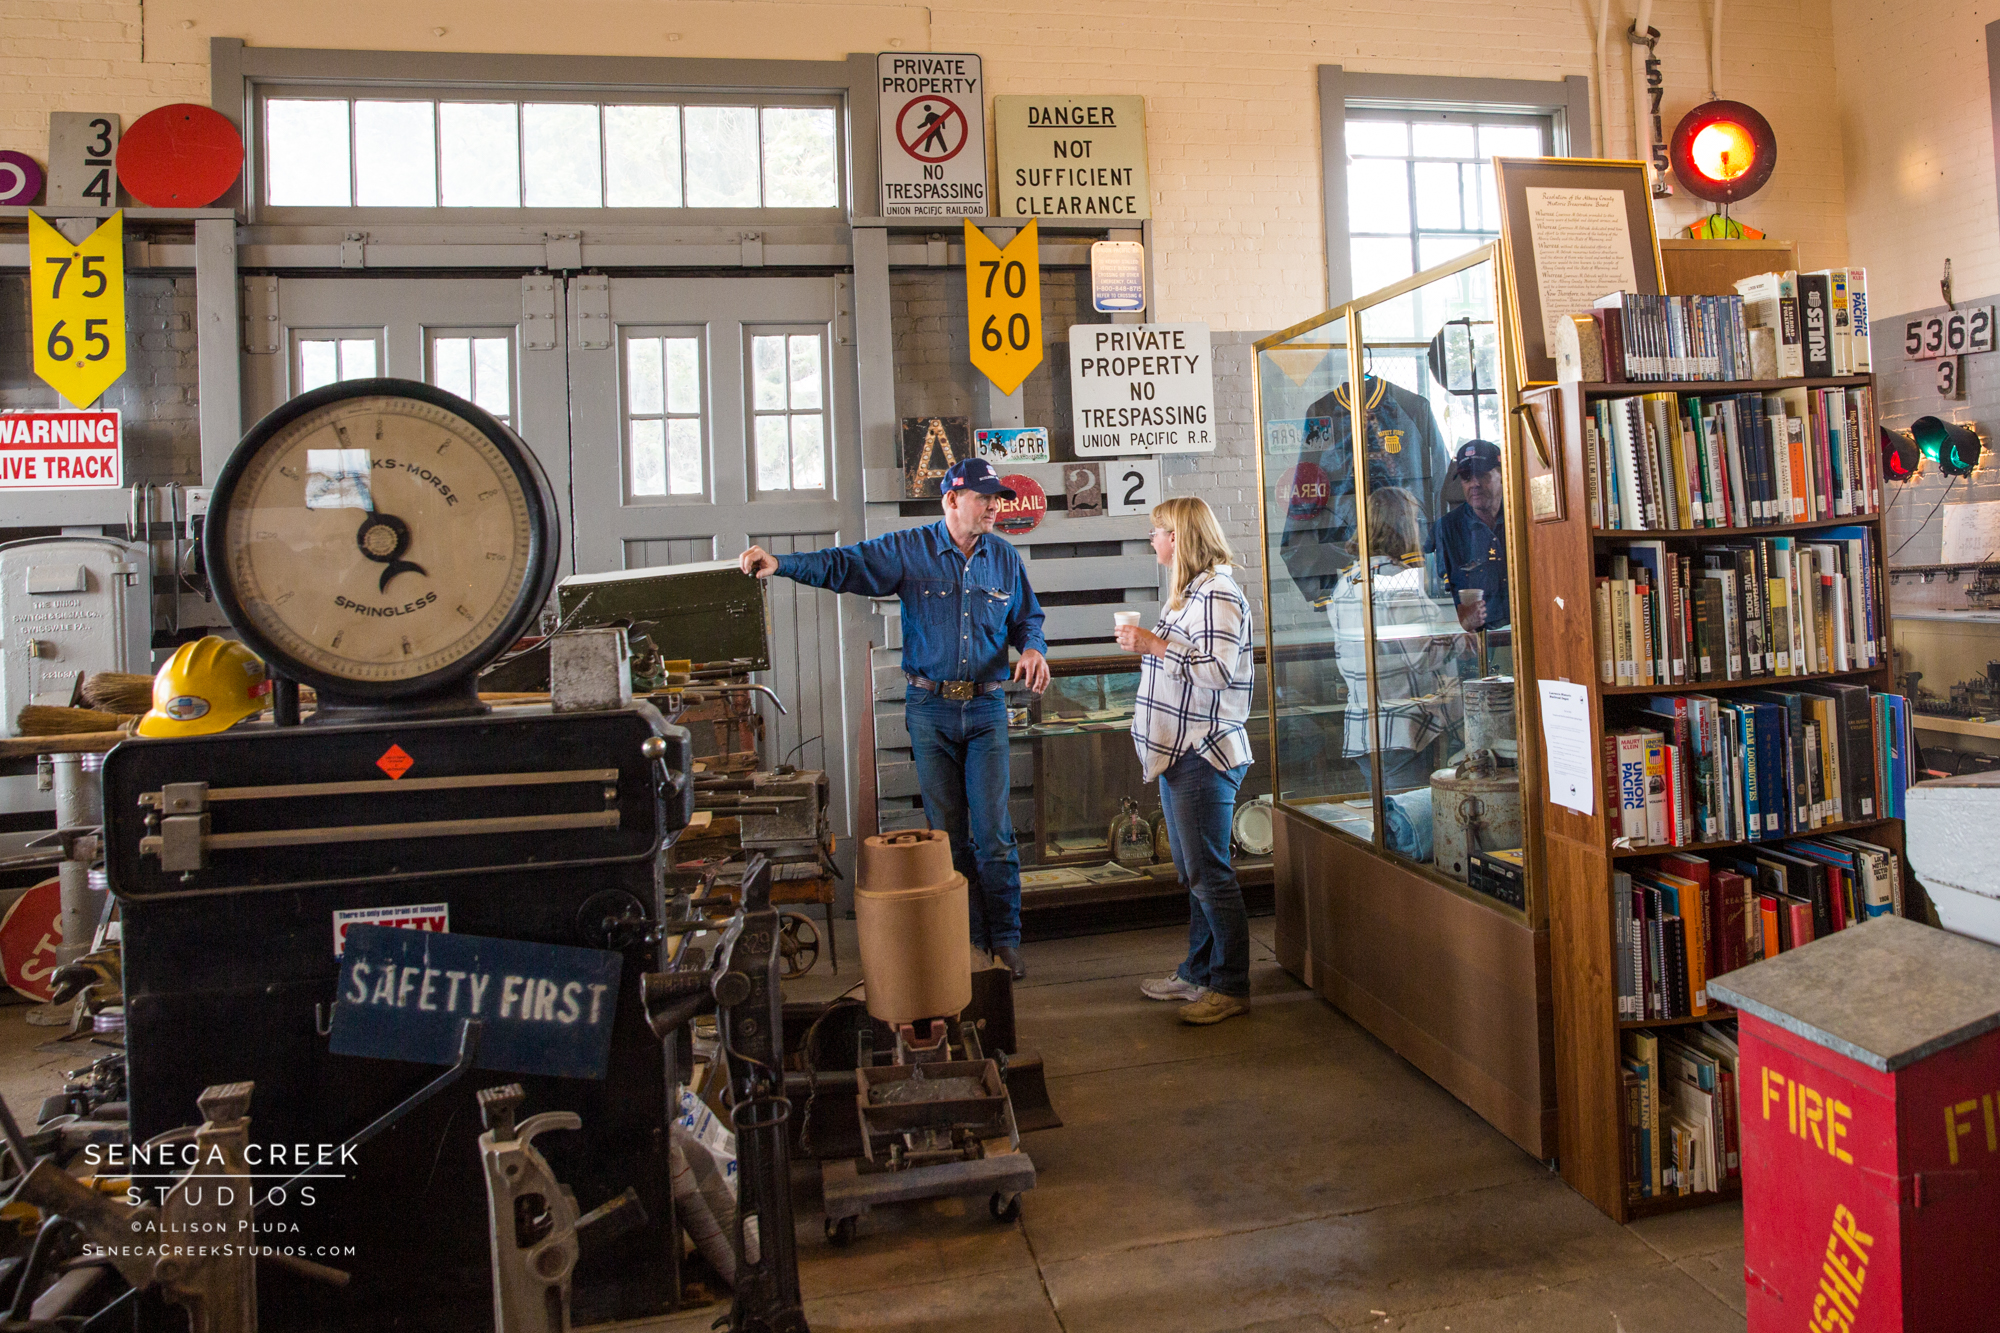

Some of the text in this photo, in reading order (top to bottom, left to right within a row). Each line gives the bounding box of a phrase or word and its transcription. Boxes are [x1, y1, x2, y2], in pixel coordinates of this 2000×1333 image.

[894, 59, 965, 75] PRIVATE
[883, 78, 977, 93] PROPERTY
[1029, 107, 1114, 124] DANGER
[86, 118, 112, 157] 3
[1054, 141, 1092, 158] NOT
[923, 165, 944, 180] NO
[1016, 168, 1132, 187] SUFFICIENT
[885, 183, 984, 199] TRESPASSING
[886, 206, 984, 216] UNION PACIFIC RAILROAD
[1016, 196, 1137, 215] CLEARANCE
[46, 256, 107, 298] 75
[979, 260, 1026, 298] 70
[1852, 292, 1864, 337] PACIFIC
[48, 319, 110, 361] 65
[981, 313, 1030, 351] 60
[1096, 331, 1185, 351] PRIVATE
[1807, 308, 1826, 361] RULES
[1906, 311, 1989, 355] 5362
[1081, 355, 1199, 377] PROPERTY
[1937, 361, 1954, 394] 3
[1130, 382, 1155, 401] NO
[1082, 405, 1207, 428] TRESPASSING
[0, 419, 114, 443] WARNING
[1083, 430, 1212, 448] UNION PACIFIC R.R.
[979, 438, 988, 456] 5
[1588, 429, 1596, 466] GRENVILLE
[0, 456, 113, 479] IVE TRACK
[1590, 467, 1596, 476] M.
[1852, 447, 1860, 480] Promontory
[1121, 471, 1145, 505] 2
[1671, 567, 1680, 618] HIGHBALL
[1744, 574, 1752, 591] WE
[334, 591, 437, 617] SPRINGLESS
[1746, 593, 1754, 619] RODE
[1642, 597, 1650, 639] RAILROAD
[1746, 718, 1757, 801] STEAM LOCOMOTIVES
[1622, 763, 1634, 810] PACIFIC
[1633, 762, 1644, 809] UNION
[339, 911, 358, 919] There
[367, 909, 380, 917] only
[395, 906, 410, 914] train
[420, 904, 445, 912] thought
[346, 962, 608, 1024] SAFETY FIRST
[1641, 1079, 1650, 1130] TRAINS
[1762, 1066, 1853, 1165] FIRE
[1944, 1091, 2000, 1165] FI
